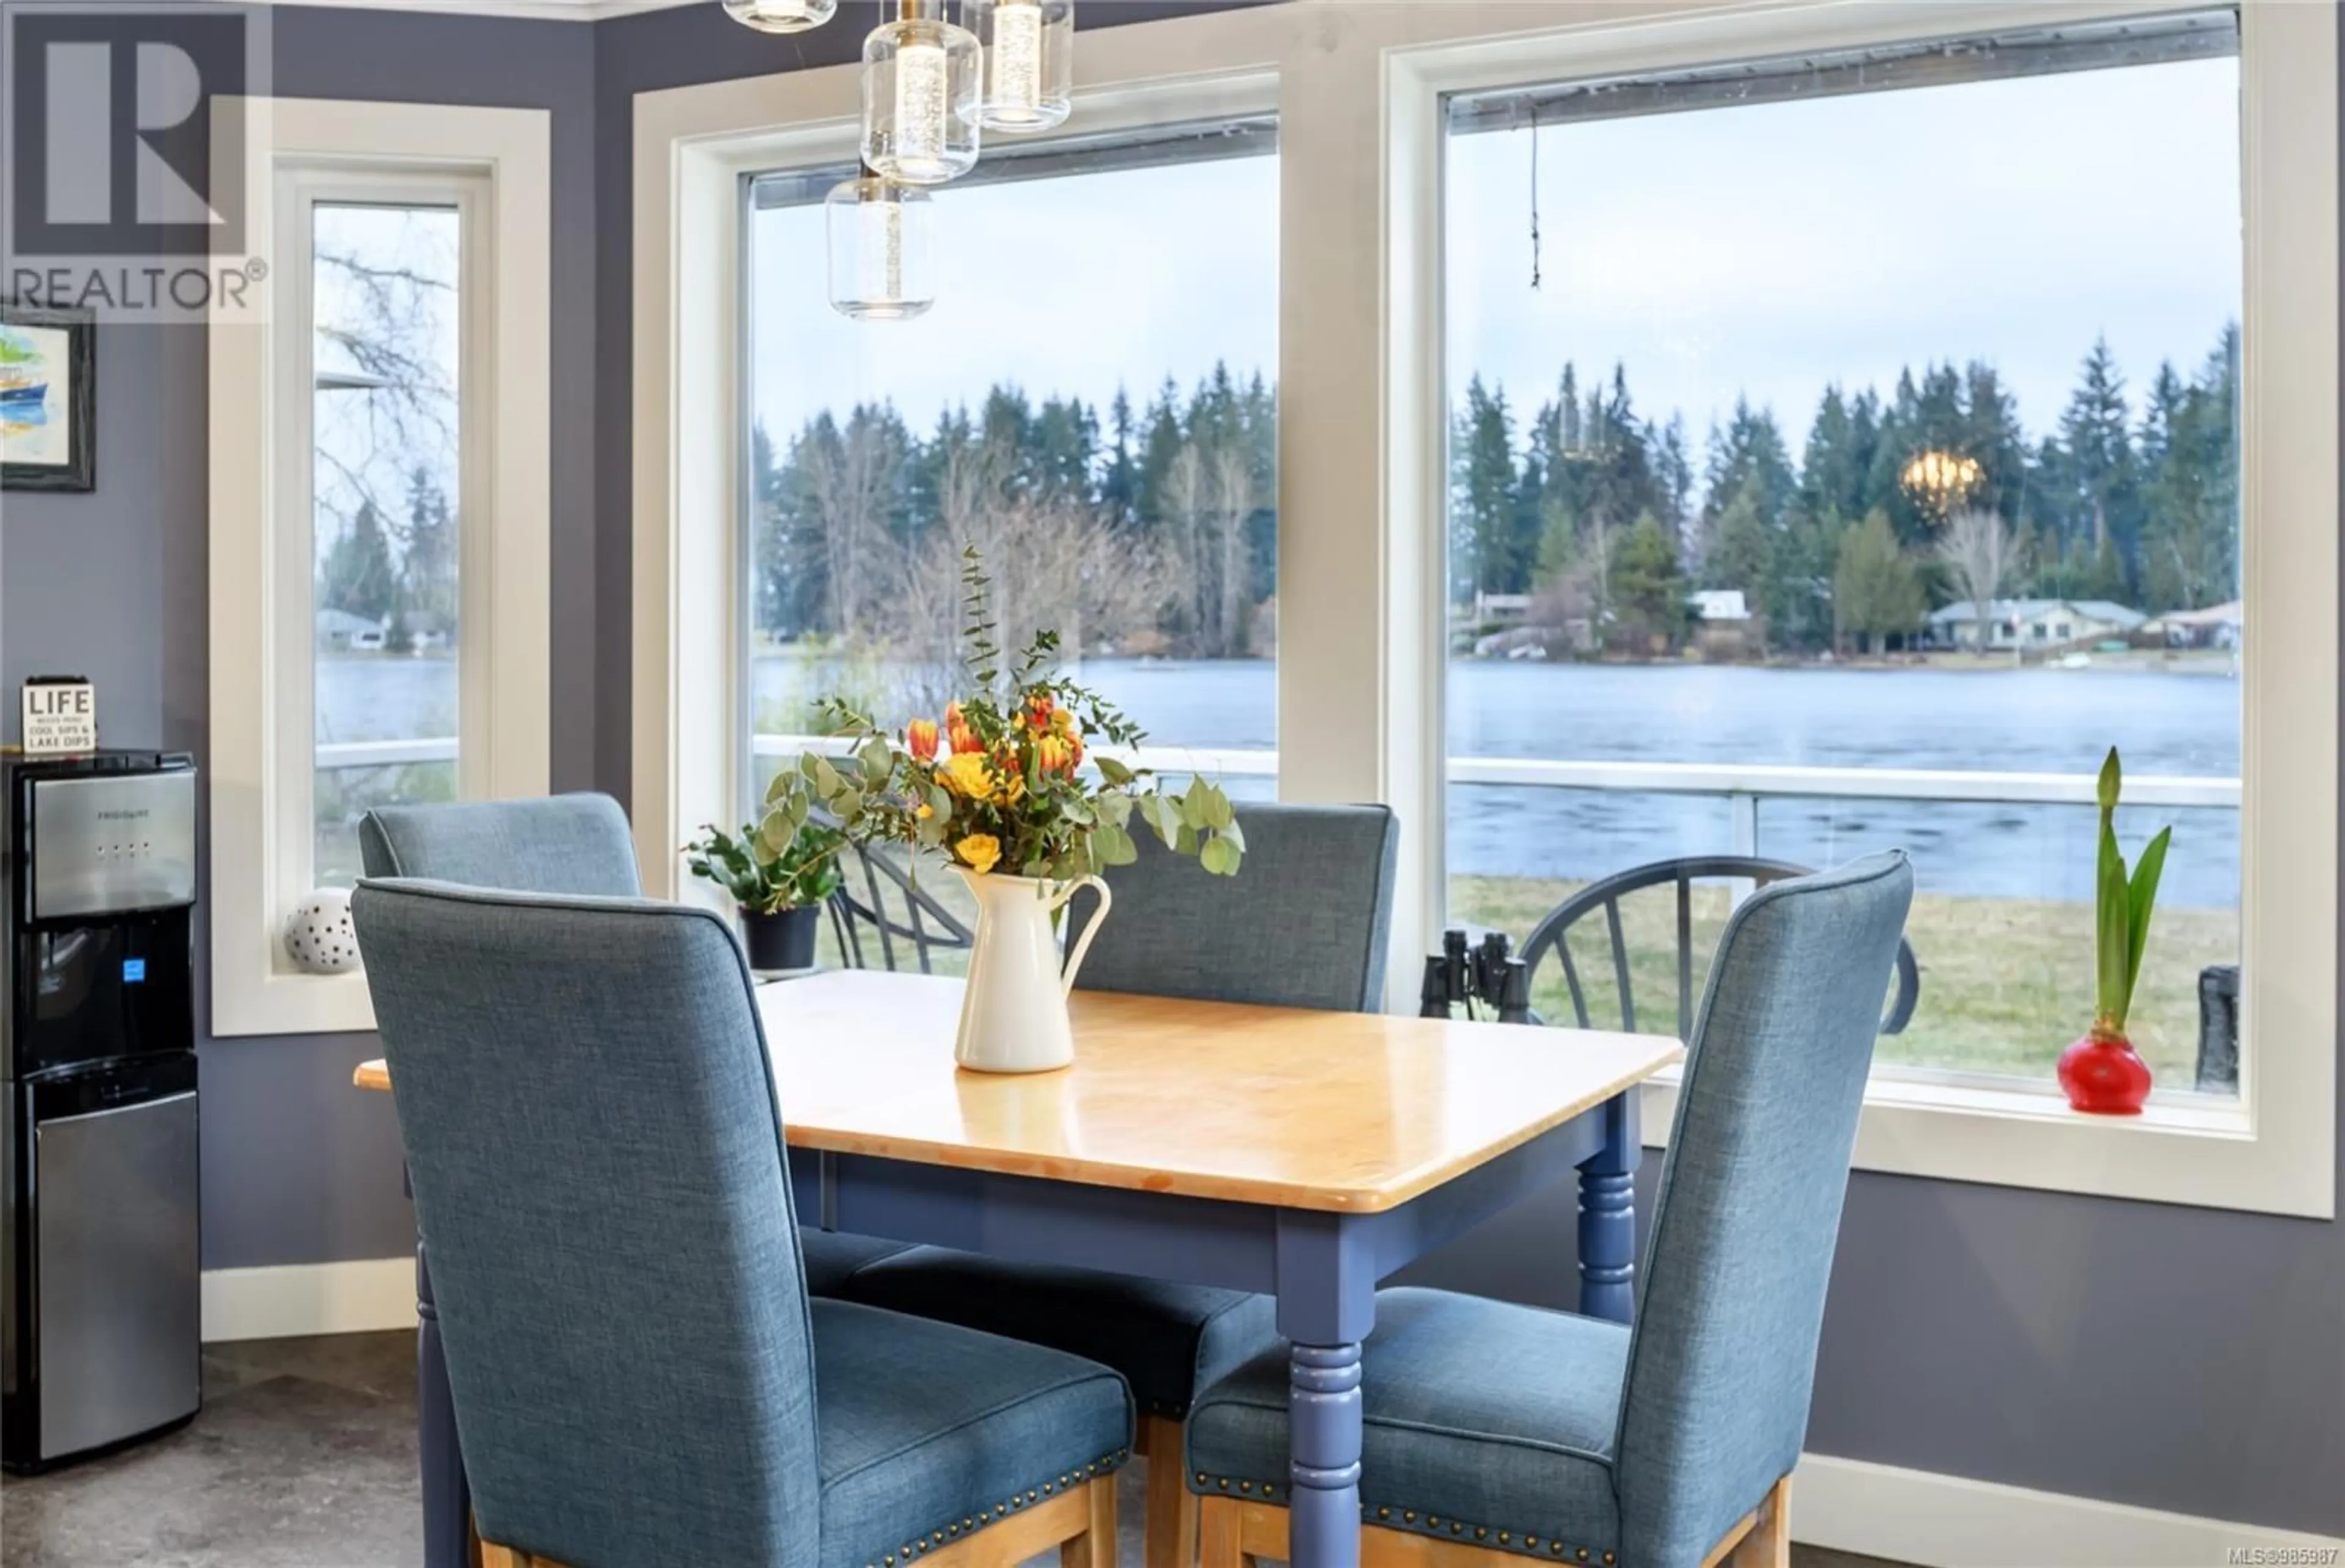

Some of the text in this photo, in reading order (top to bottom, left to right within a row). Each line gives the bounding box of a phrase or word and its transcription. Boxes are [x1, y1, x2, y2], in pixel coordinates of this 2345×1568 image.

[29, 691, 89, 714] LIFE
[58, 725, 78, 735] SIPS
[30, 736, 90, 748] LAKE DIPS
